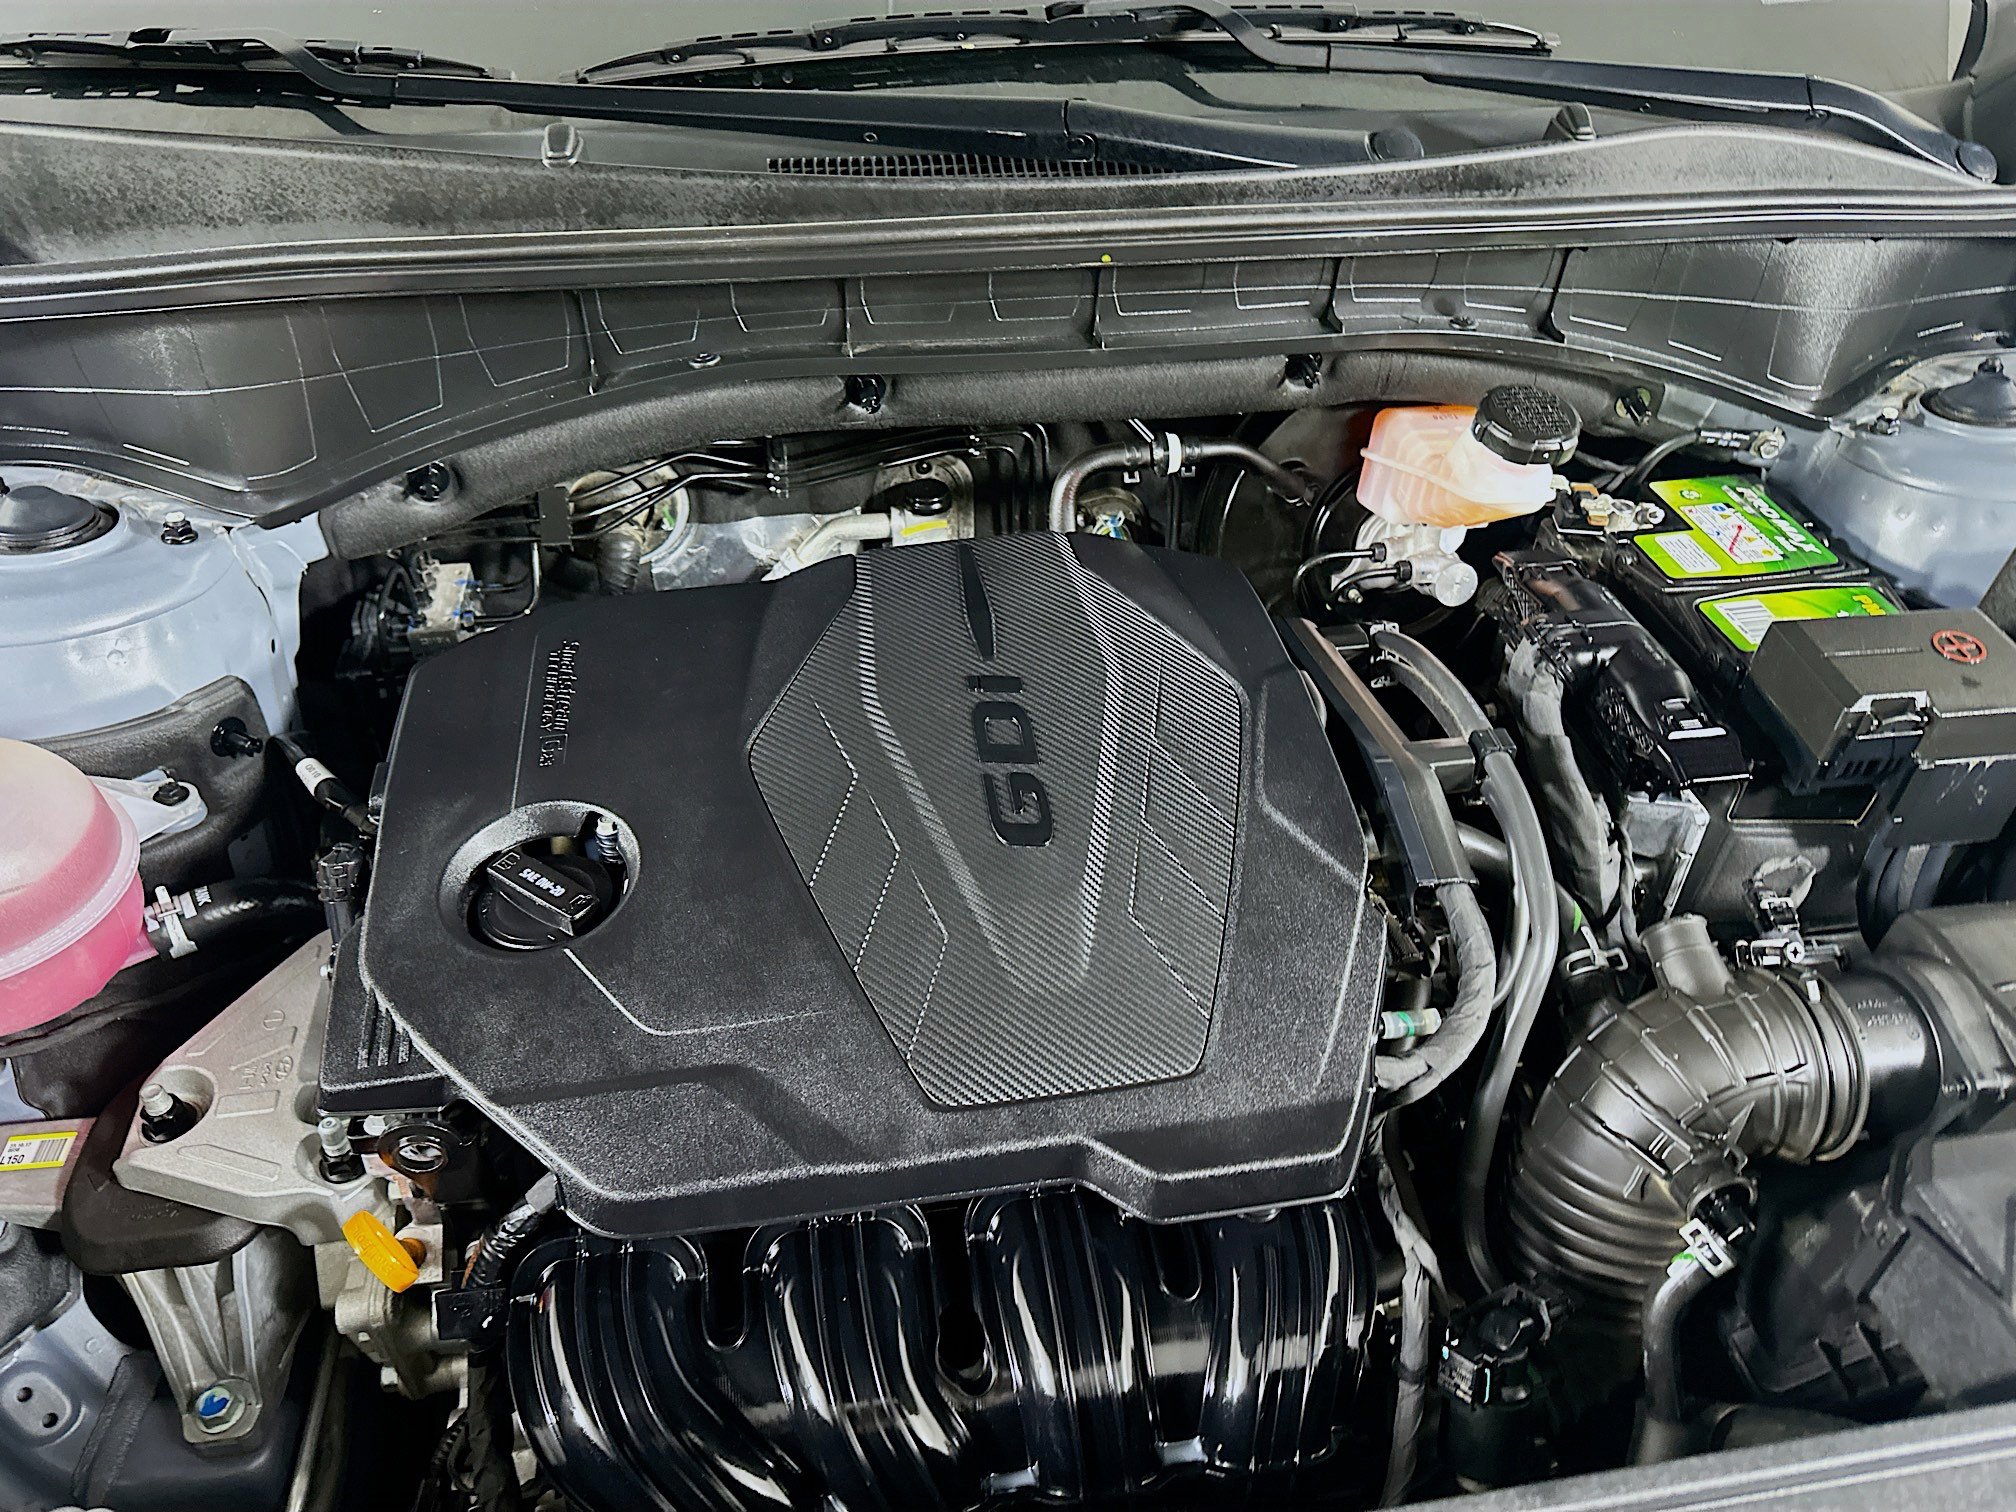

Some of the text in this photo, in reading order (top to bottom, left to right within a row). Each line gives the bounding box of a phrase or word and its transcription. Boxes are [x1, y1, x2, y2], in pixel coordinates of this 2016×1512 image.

[540, 650, 560, 732] TECHNOLOGY
[552, 640, 580, 731] Smartstream
[518, 868, 541, 883] SAE
